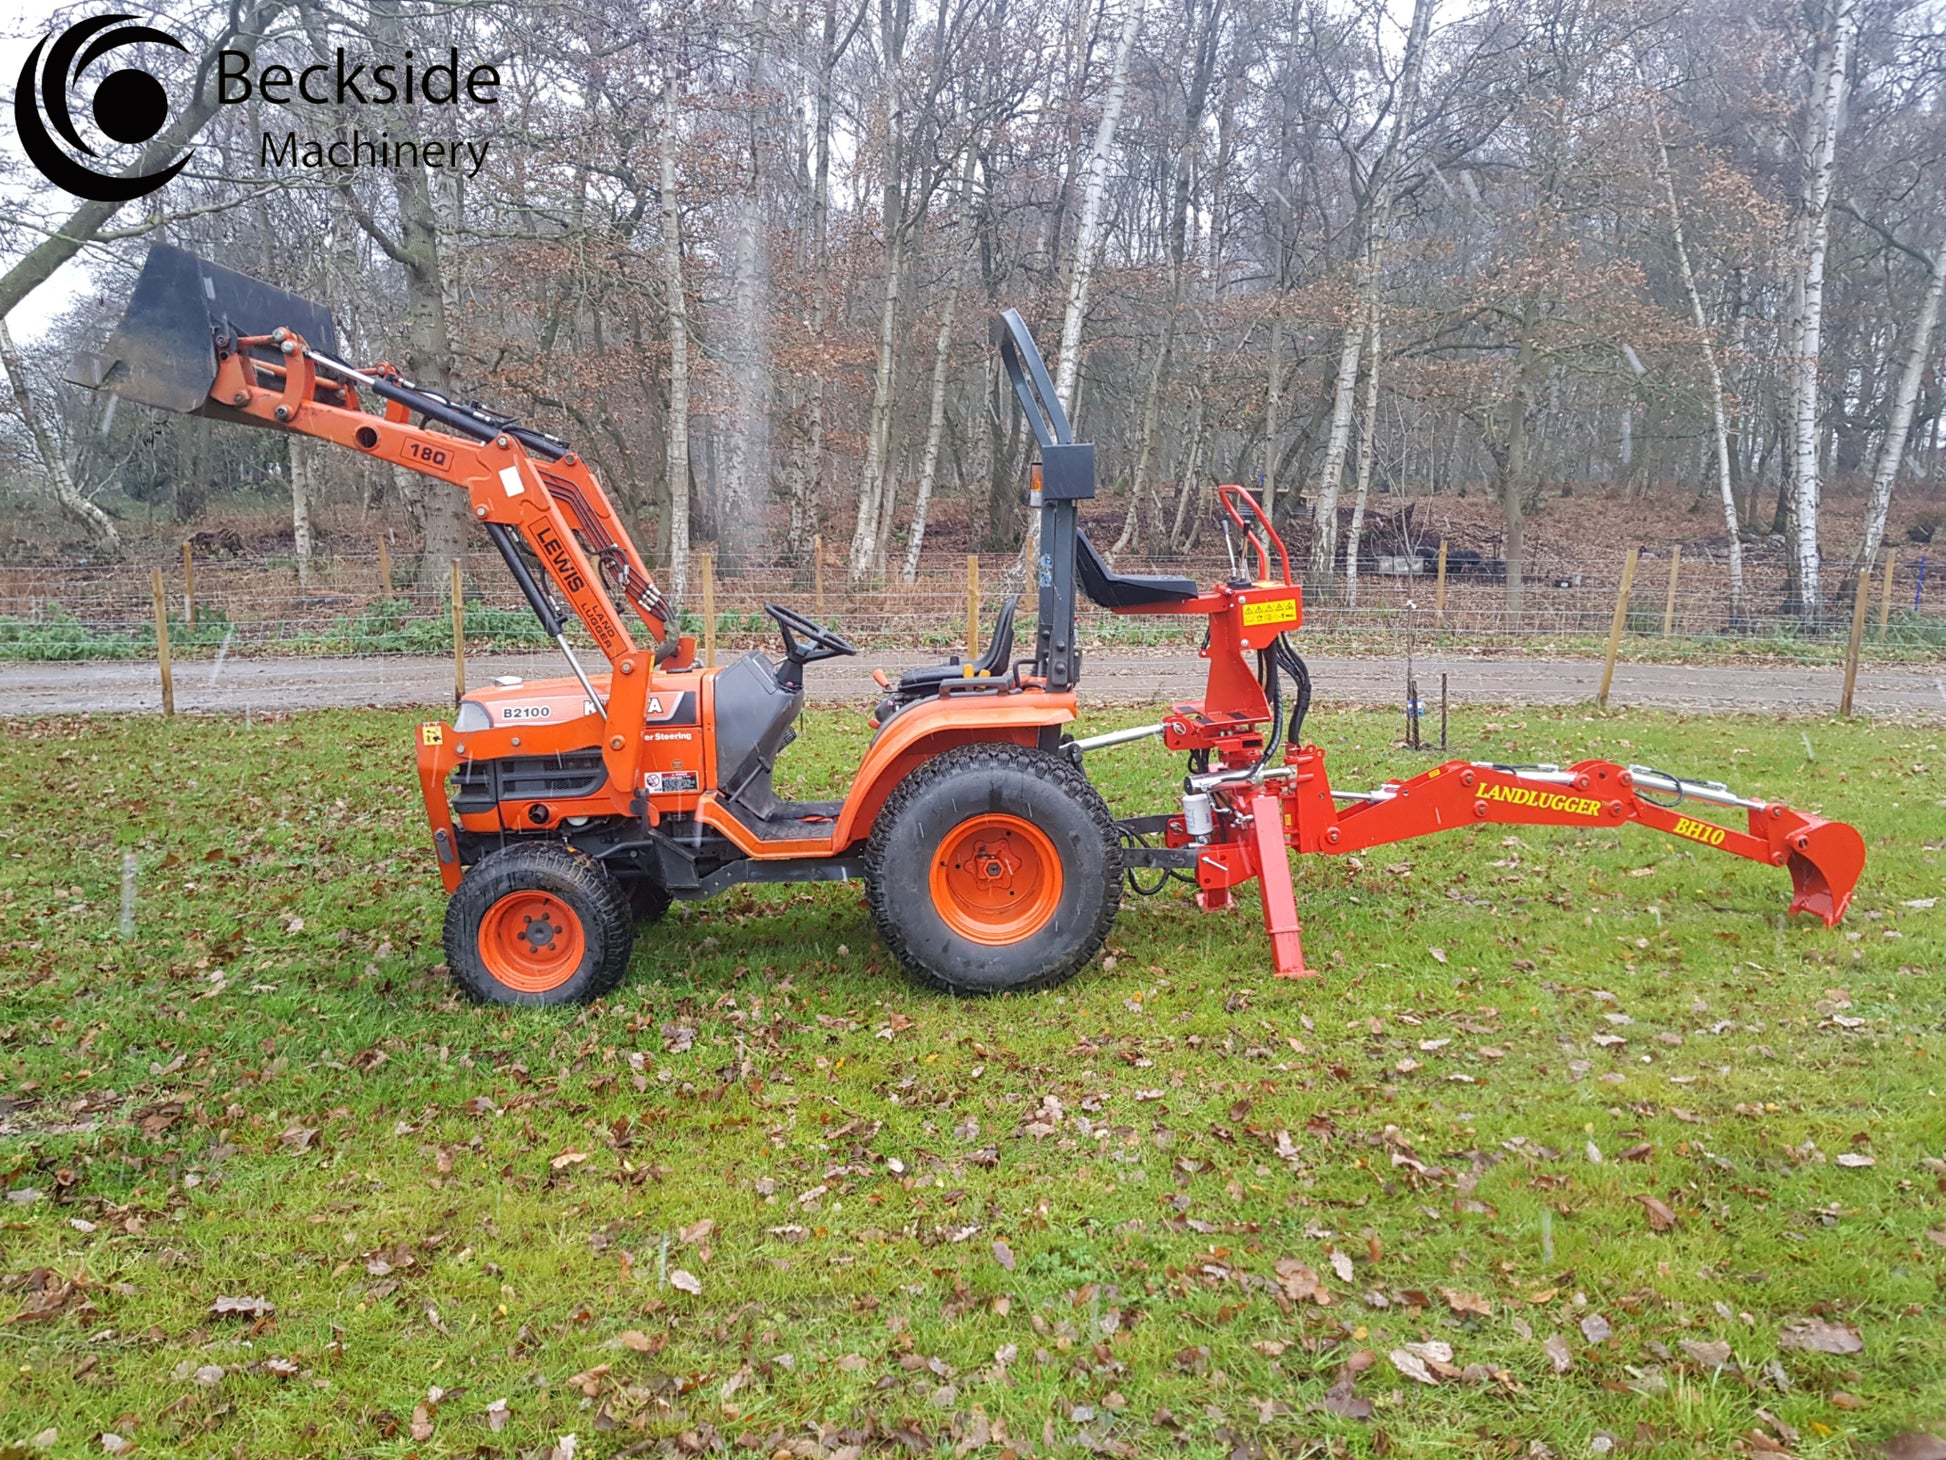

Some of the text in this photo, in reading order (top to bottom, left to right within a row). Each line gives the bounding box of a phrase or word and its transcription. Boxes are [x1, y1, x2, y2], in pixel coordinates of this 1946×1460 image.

[536, 527, 585, 593] LEWIS
[580, 602, 612, 649] LUGGER
[592, 604, 615, 638] LAND
[503, 706, 550, 718] B2100
[654, 731, 692, 741] Steering
[1475, 782, 1601, 817] LANDLUGGER
[1673, 817, 1726, 846] BH10
